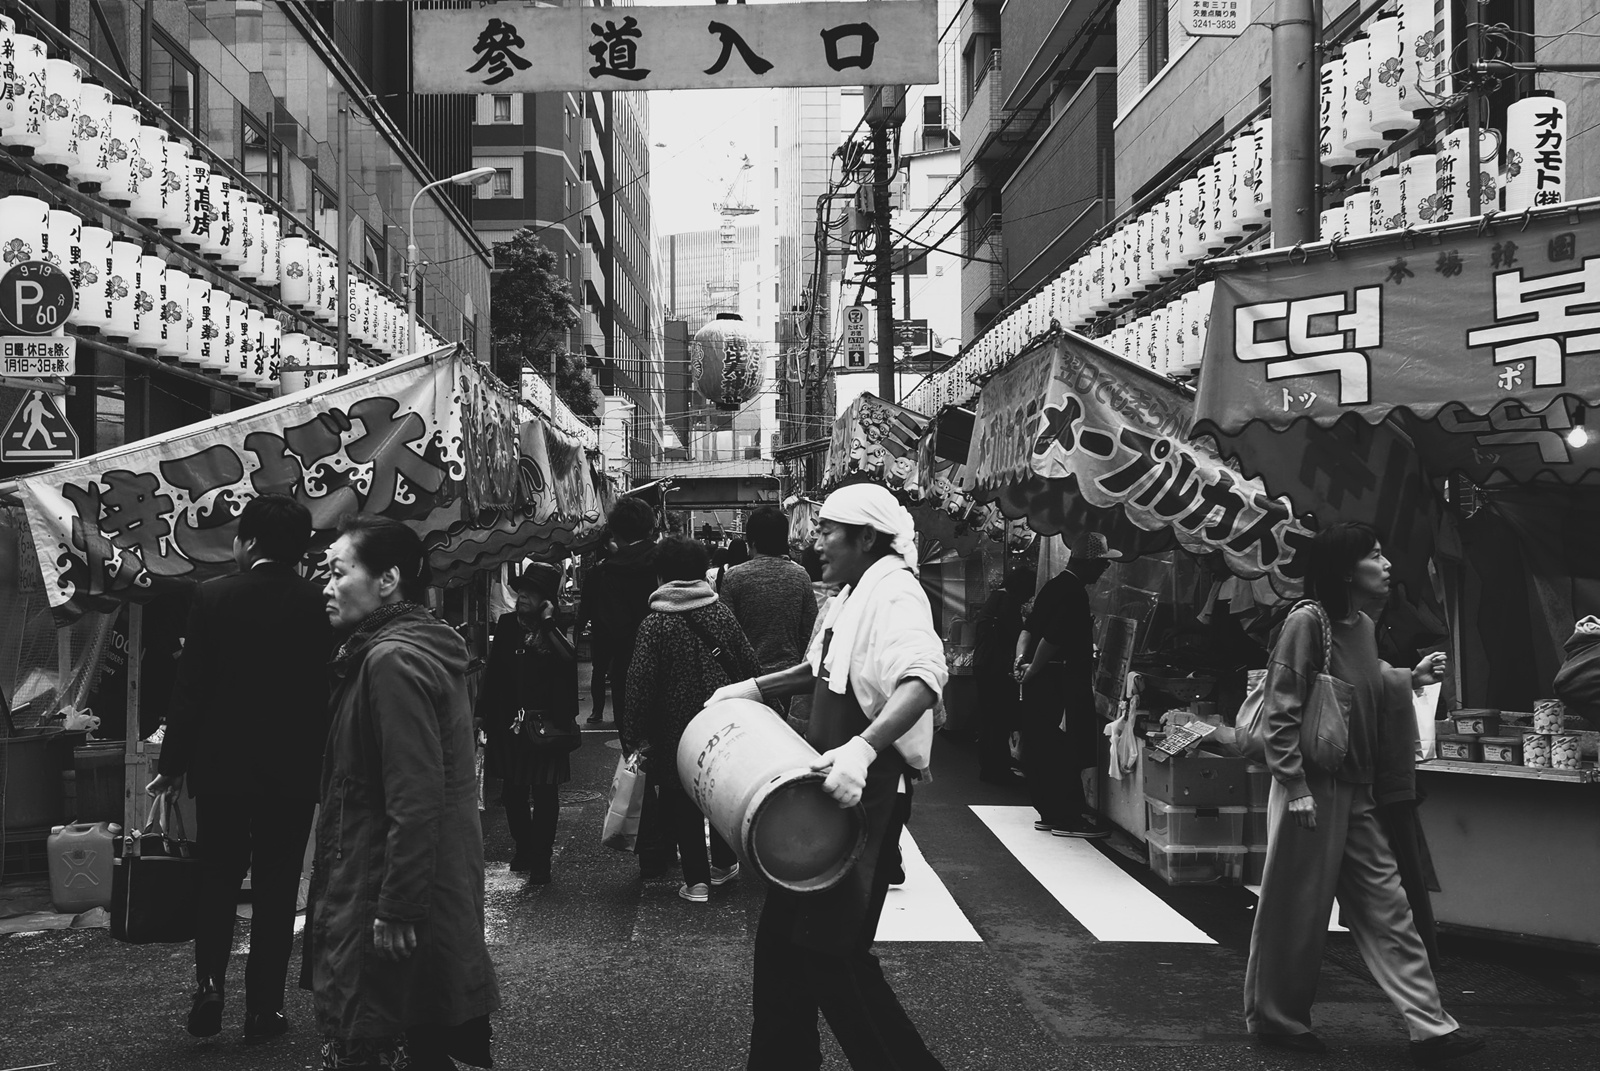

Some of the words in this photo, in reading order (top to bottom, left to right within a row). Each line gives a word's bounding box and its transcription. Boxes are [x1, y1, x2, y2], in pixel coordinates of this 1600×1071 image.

[1193, 19, 1237, 29] 3241-3838
[20, 264, 52, 277] 9-19
[15, 280, 44, 325] P
